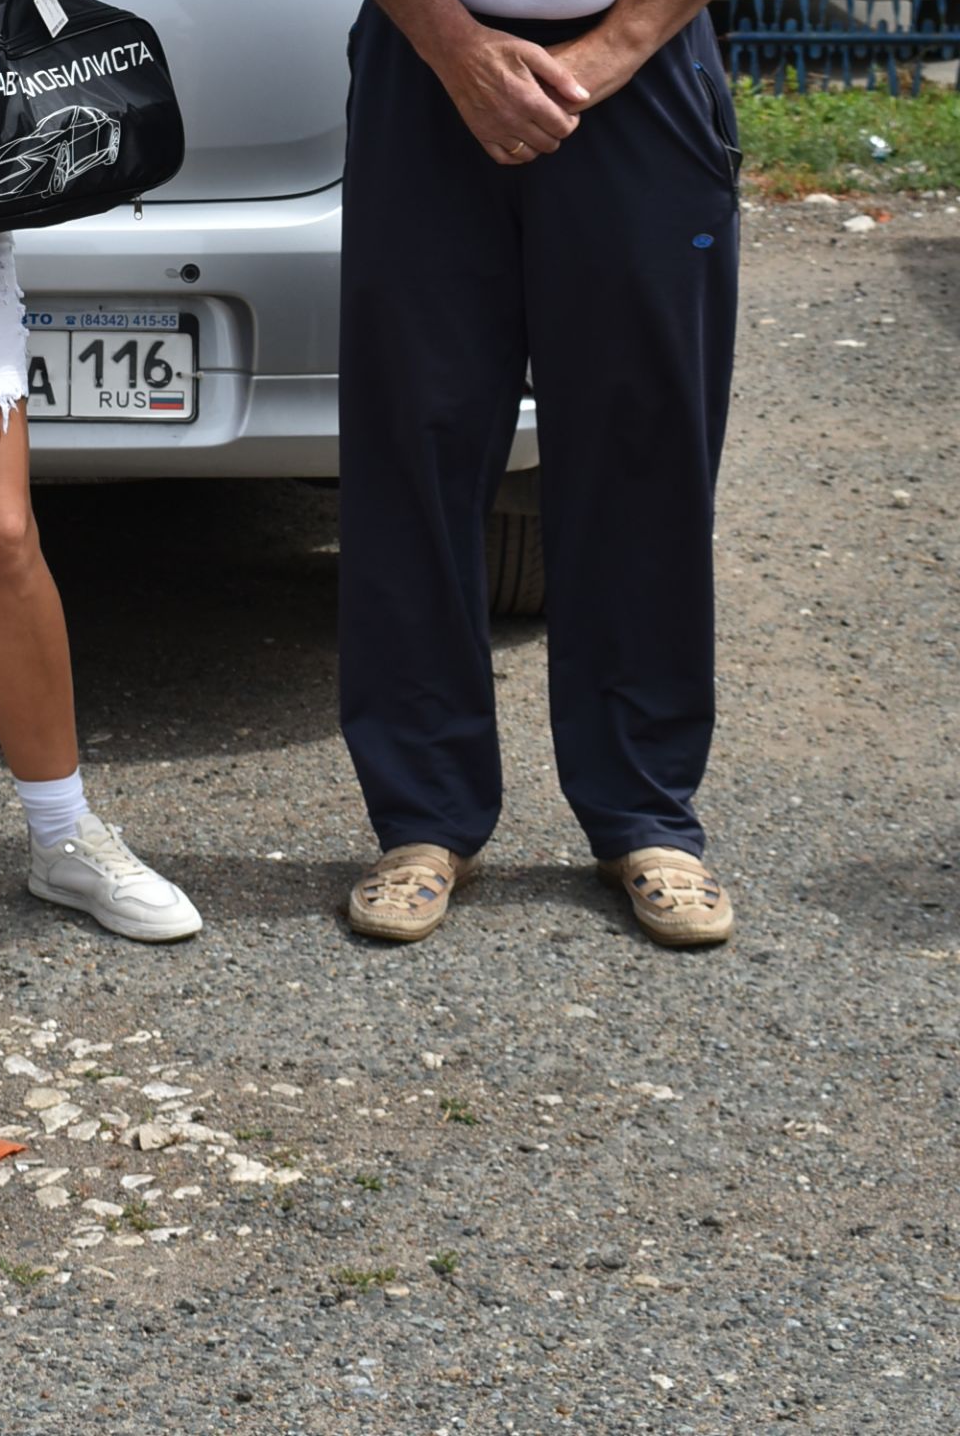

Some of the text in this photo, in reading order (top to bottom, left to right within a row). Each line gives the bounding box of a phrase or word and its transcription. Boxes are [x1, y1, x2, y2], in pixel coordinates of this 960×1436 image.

[80, 314, 129, 328] (84342)
[132, 315, 177, 327] 415-55
[78, 339, 173, 389] 116
[99, 390, 147, 408] RUS
